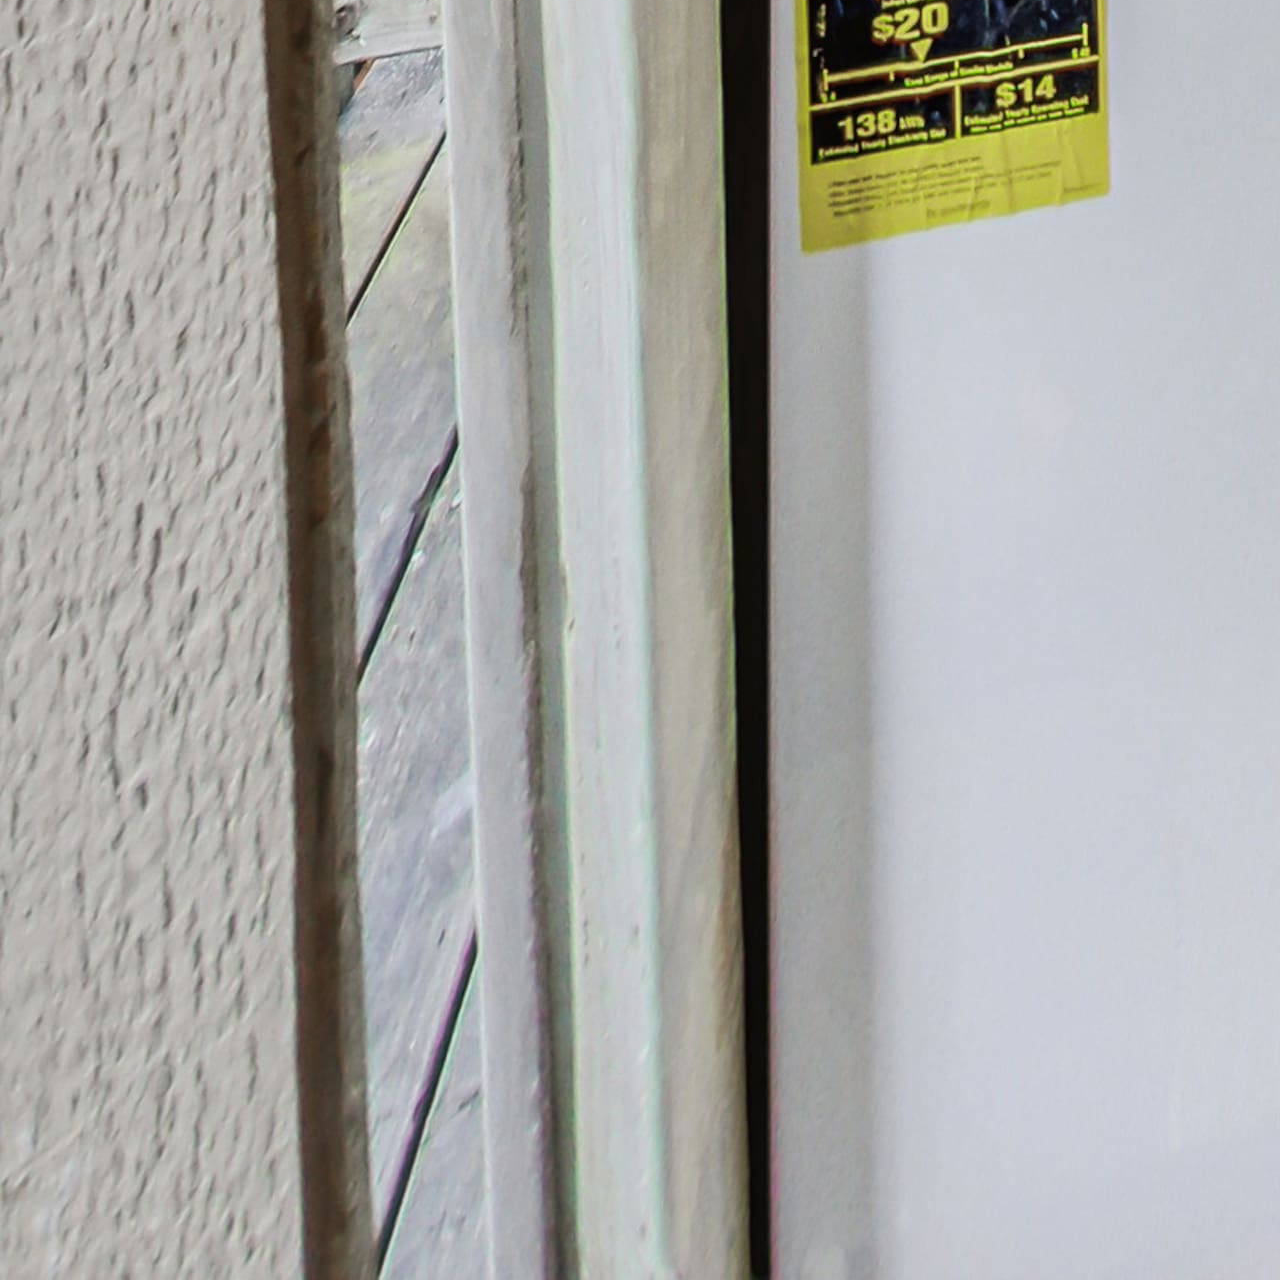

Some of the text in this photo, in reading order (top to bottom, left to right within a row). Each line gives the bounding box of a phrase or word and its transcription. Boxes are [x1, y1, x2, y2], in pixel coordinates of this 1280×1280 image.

[872, 1, 949, 42] $20
[996, 74, 1056, 108] $14
[837, 108, 896, 140] 138
